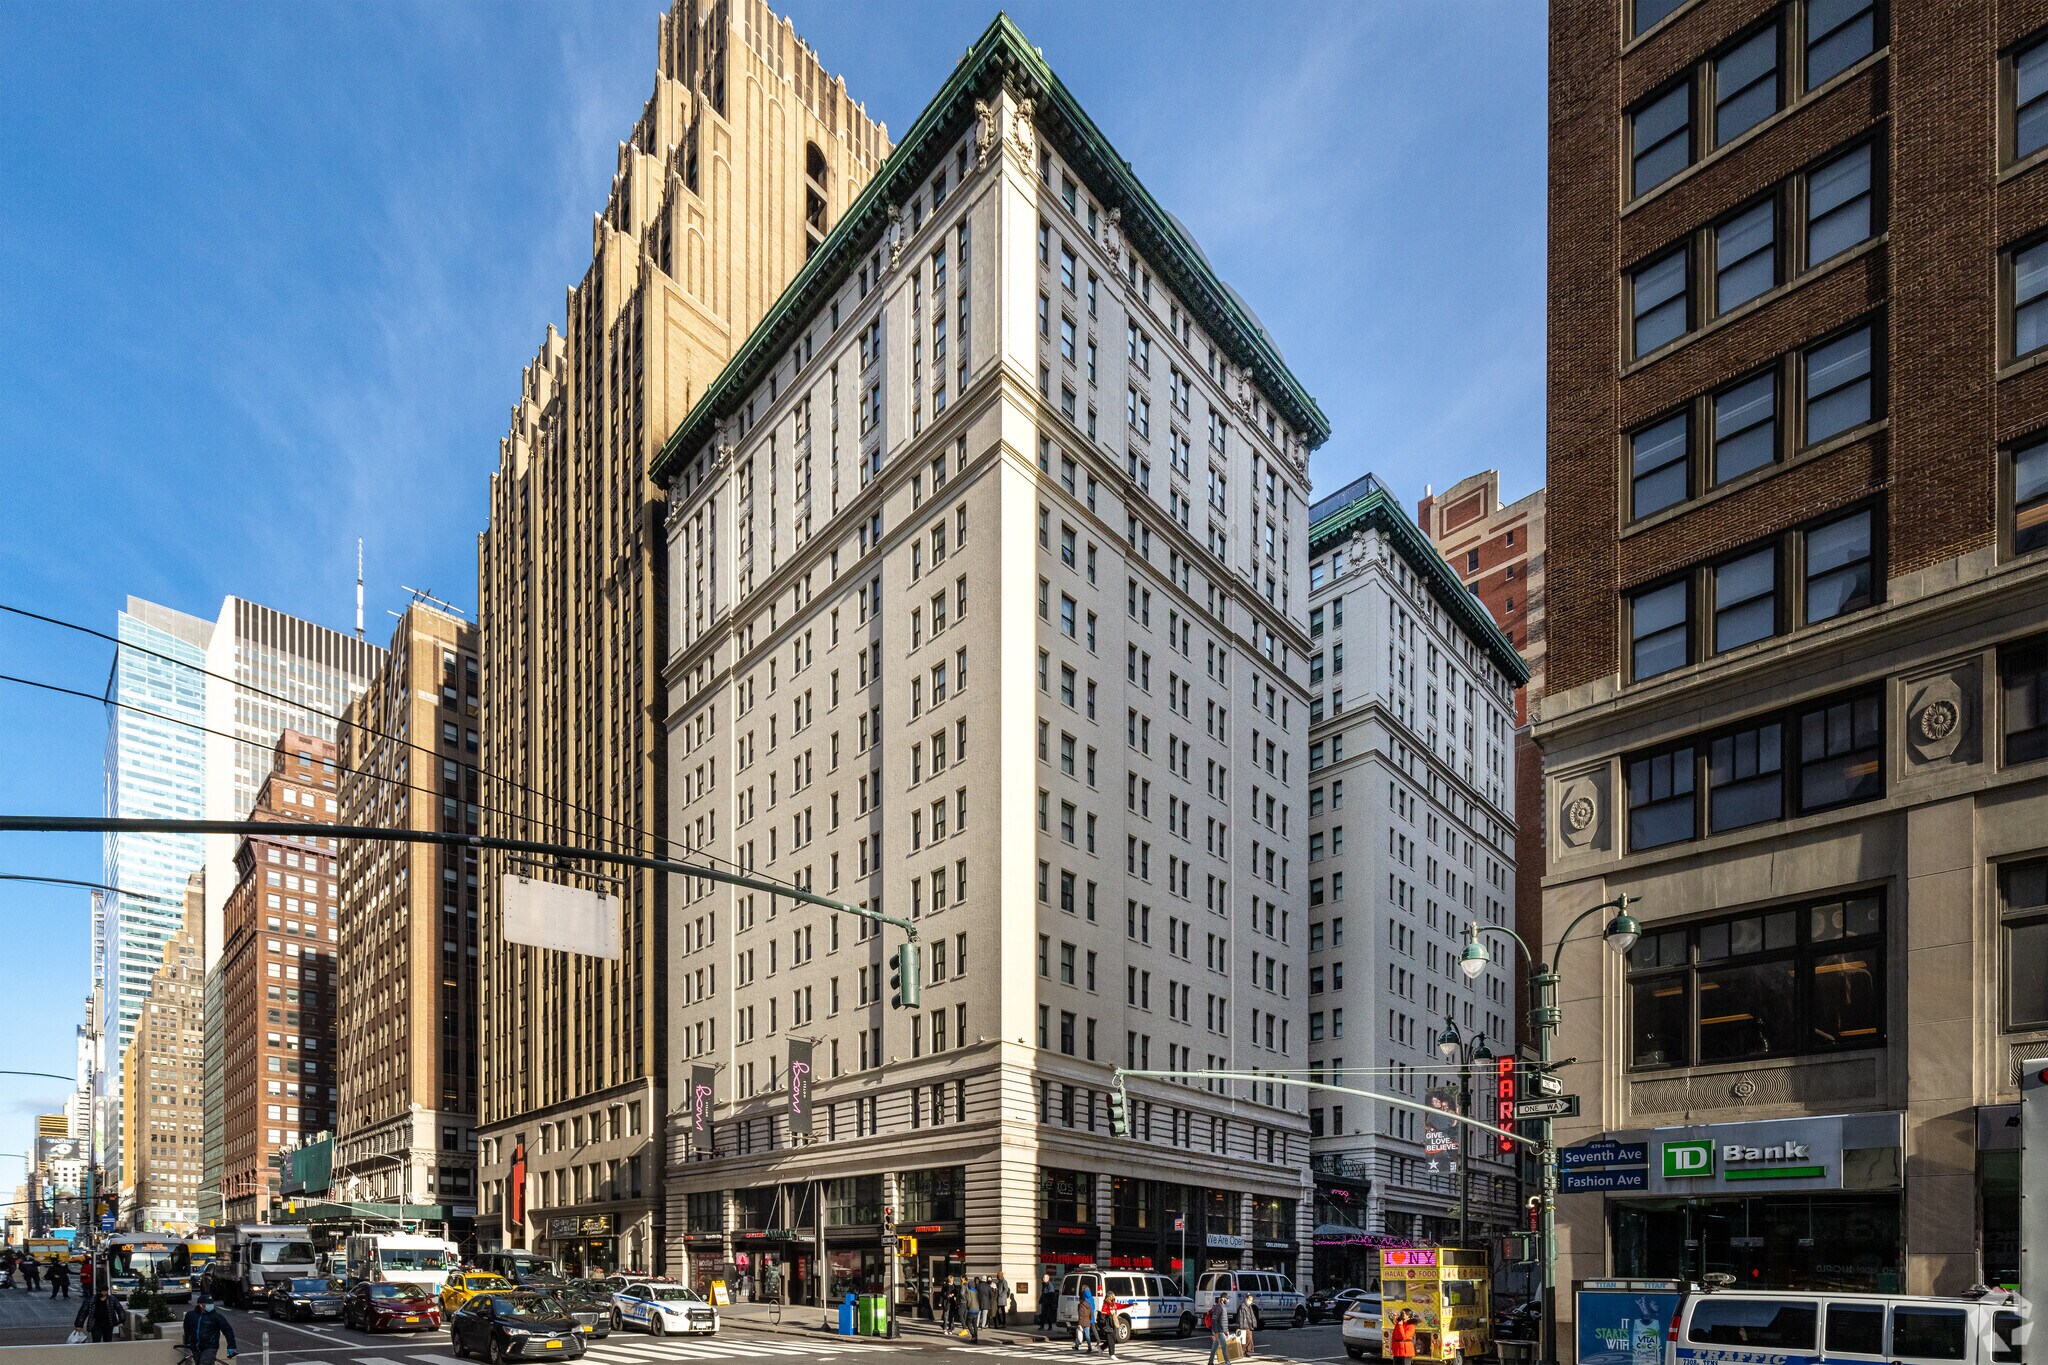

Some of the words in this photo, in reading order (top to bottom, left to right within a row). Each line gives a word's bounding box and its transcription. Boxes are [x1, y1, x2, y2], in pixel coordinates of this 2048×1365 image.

[792, 1060, 810, 1114] moxy
[1499, 1058, 1513, 1141] PARK
[696, 1084, 712, 1131] moxy
[1524, 1105, 1539, 1113] ONE
[1425, 1132, 1444, 1140] GIVE.
[1426, 1143, 1458, 1151] BELIEVE.
[1565, 1149, 1614, 1163] Seventh
[1618, 1149, 1642, 1160] Ave
[1667, 1146, 1708, 1170] TD
[1723, 1141, 1809, 1161] Bank
[1568, 1176, 1613, 1187] Fashion
[1617, 1175, 1641, 1186] Ave
[1207, 1235, 1218, 1244] We
[1218, 1236, 1229, 1245] Are
[1230, 1236, 1245, 1247] Open
[1385, 1252, 1391, 1264] I
[1408, 1251, 1434, 1264] NY
[1157, 1304, 1177, 1313] NYPD
[1621, 1318, 1630, 1329] IT
[1595, 1327, 1630, 1340] STARTS
[1605, 1338, 1630, 1350] WITH
[1693, 1348, 1788, 1365] TRAFFIC
